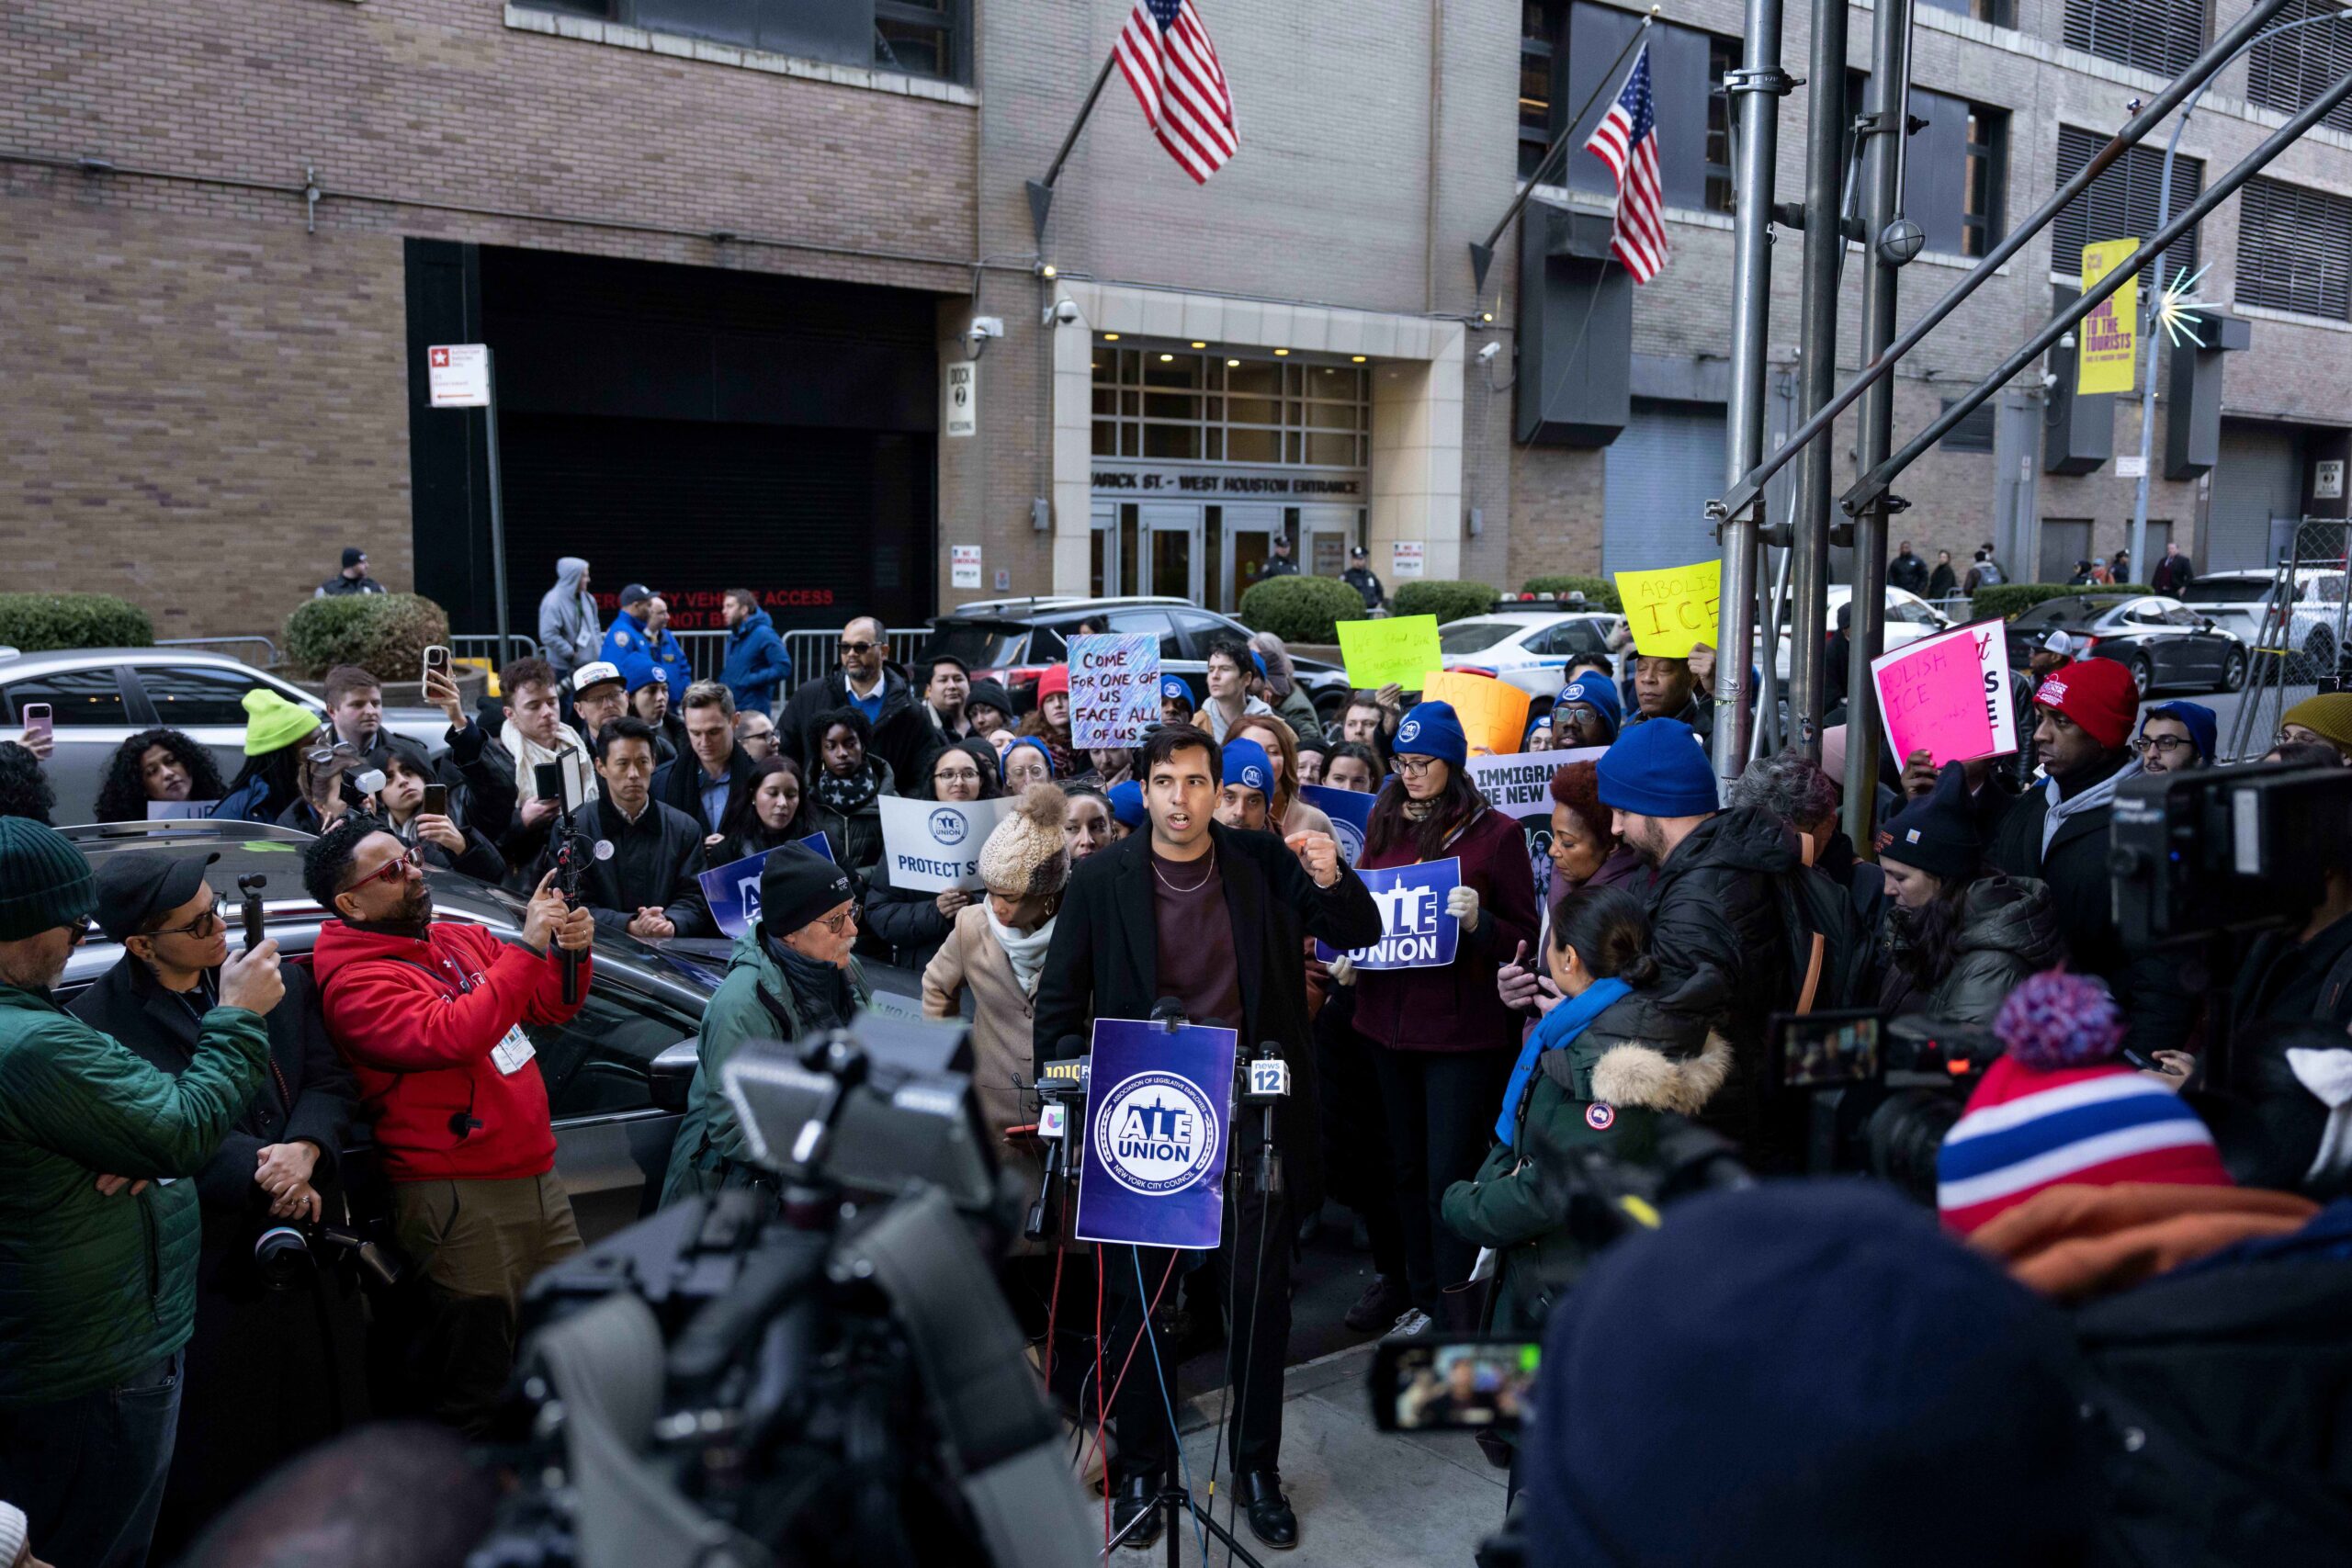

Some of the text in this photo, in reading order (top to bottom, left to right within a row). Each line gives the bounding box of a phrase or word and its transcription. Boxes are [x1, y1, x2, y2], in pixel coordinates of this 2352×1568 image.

[2086, 317, 2118, 335] TO THE
[2086, 333, 2131, 353] TOURISTS
[951, 368, 971, 385] DOCK
[1143, 474, 1164, 490] ST.
[1180, 476, 1219, 491] WEST
[1224, 477, 1289, 493] HOUSTON
[1293, 479, 1360, 494] ENTRANCE
[1641, 573, 1718, 600] ABOLIS
[764, 590, 834, 606] ACCESS
[1639, 596, 1720, 637] ICE
[1083, 651, 1128, 669] COME
[1071, 671, 1158, 689] FOR ONE OF
[1099, 690, 1121, 704] US
[1893, 682, 1930, 721] ICE
[1076, 707, 1159, 723] FACE ALL
[1093, 728, 1137, 741] OF US
[1506, 784, 1545, 805] NEW
[898, 855, 961, 878] PROTECT
[1113, 1078, 1144, 1103] ASSOCIATION
[1153, 1077, 1184, 1089] LEGISLATIVE
[1254, 1070, 1280, 1090] 12
[1119, 1109, 1193, 1145] ALE
[1118, 1141, 1190, 1163] UNION
[1114, 1164, 1195, 1190] NEW YORK CITY COUNCIL
